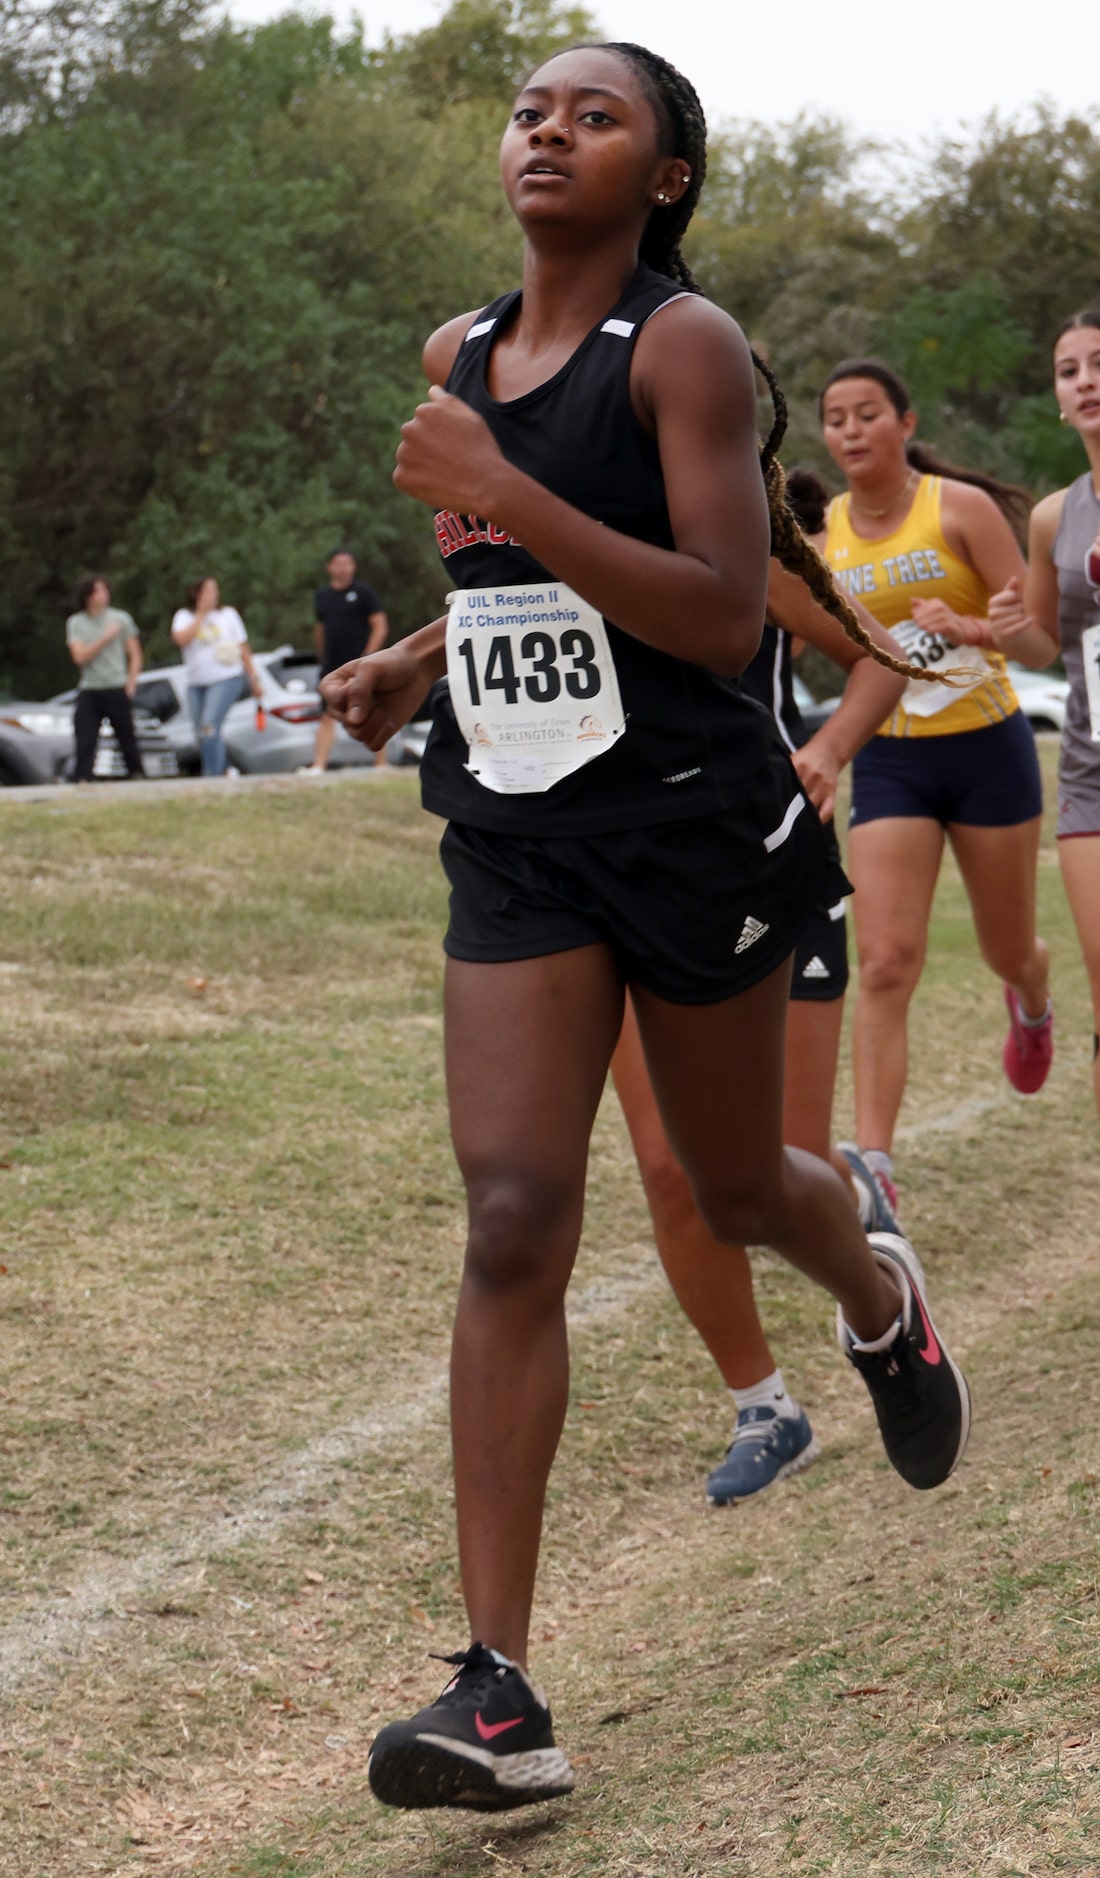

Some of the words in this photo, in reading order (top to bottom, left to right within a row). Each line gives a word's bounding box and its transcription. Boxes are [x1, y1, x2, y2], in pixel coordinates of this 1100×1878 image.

[433, 509, 522, 558] HILLC
[834, 563, 877, 595] INE
[882, 549, 947, 587] TREE
[467, 595, 491, 608] UIL
[495, 591, 545, 607] Region
[549, 590, 559, 603] II
[458, 615, 473, 628] XC
[476, 608, 580, 627] Championship
[458, 629, 601, 706] 1433
[498, 728, 565, 742] ARLINGTON
